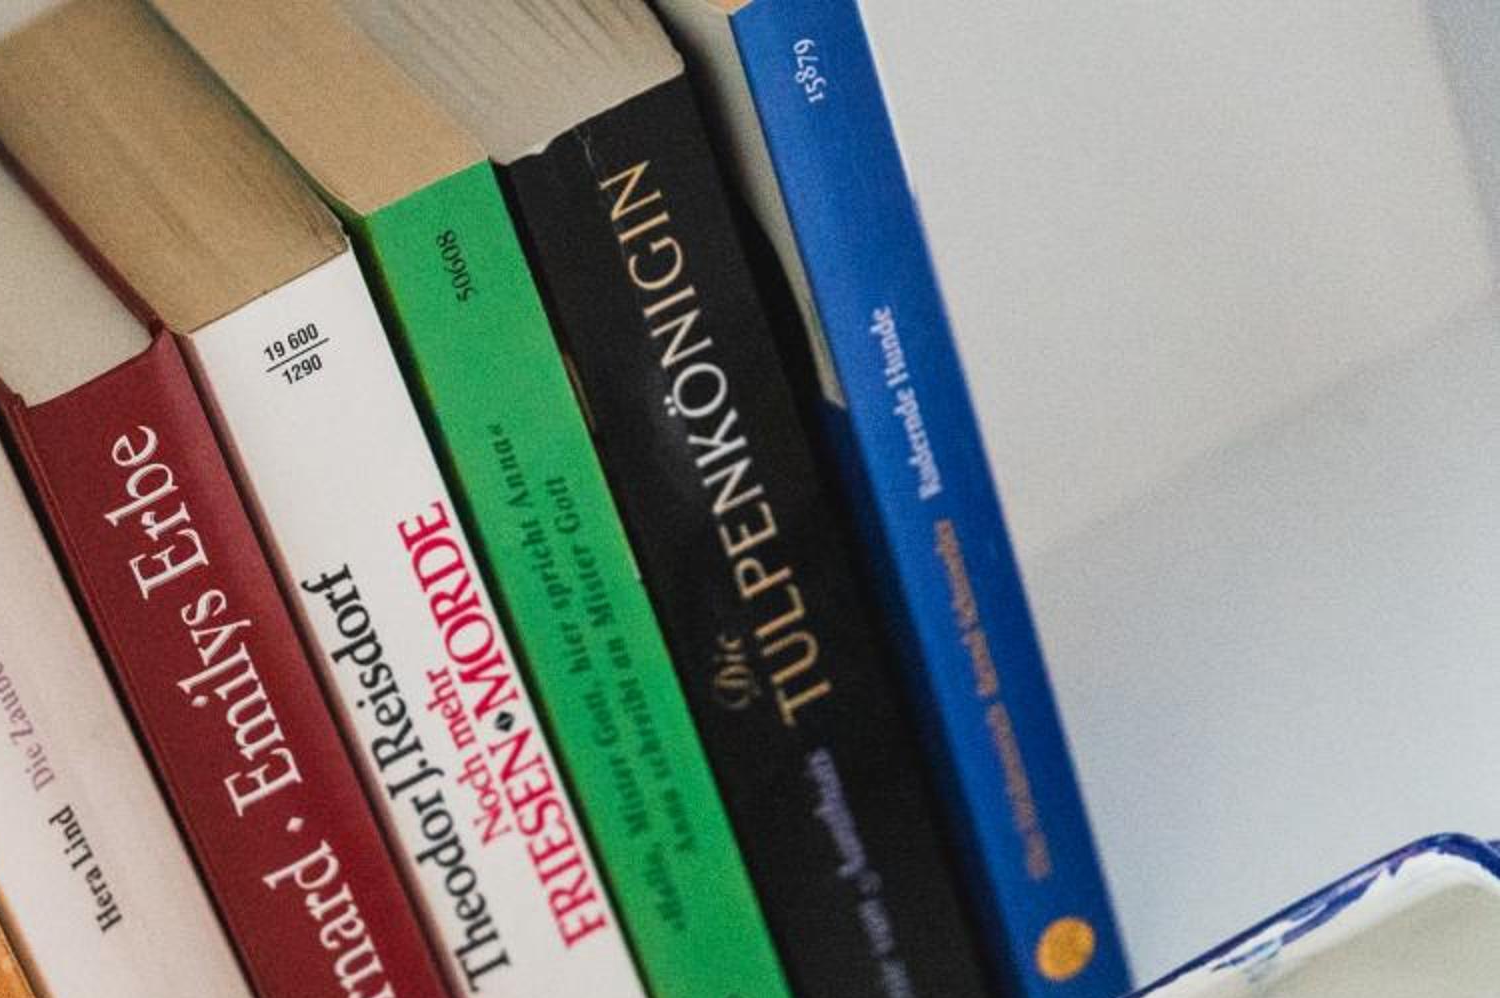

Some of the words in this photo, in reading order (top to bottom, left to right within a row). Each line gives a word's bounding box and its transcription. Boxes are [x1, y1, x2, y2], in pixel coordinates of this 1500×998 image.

[792, 37, 827, 104] 15879
[435, 228, 477, 303] 50608
[262, 340, 286, 363] 19
[287, 322, 322, 351] 600
[282, 355, 324, 386] 1290
[869, 306, 909, 388] Hunde
[598, 160, 831, 724] TULPENKÖNIGIN
[892, 387, 942, 500] Rudernde
[103, 425, 210, 600] Erbe
[543, 475, 583, 537] Gott
[520, 518, 574, 612] spricht
[571, 544, 616, 629] Mister
[559, 621, 593, 676] hier
[606, 636, 633, 671] an
[713, 633, 761, 710] Die
[176, 588, 303, 817] Emilys
[425, 666, 477, 751] mehr
[617, 677, 673, 781] schreibt
[27, 742, 57, 792] Die
[456, 752, 512, 846] Noch
[608, 755, 652, 839] Mister
[48, 804, 94, 870] Lind
[660, 787, 698, 854] Anna
[85, 865, 123, 933] Hera
[410, 790, 511, 994] Theodor
